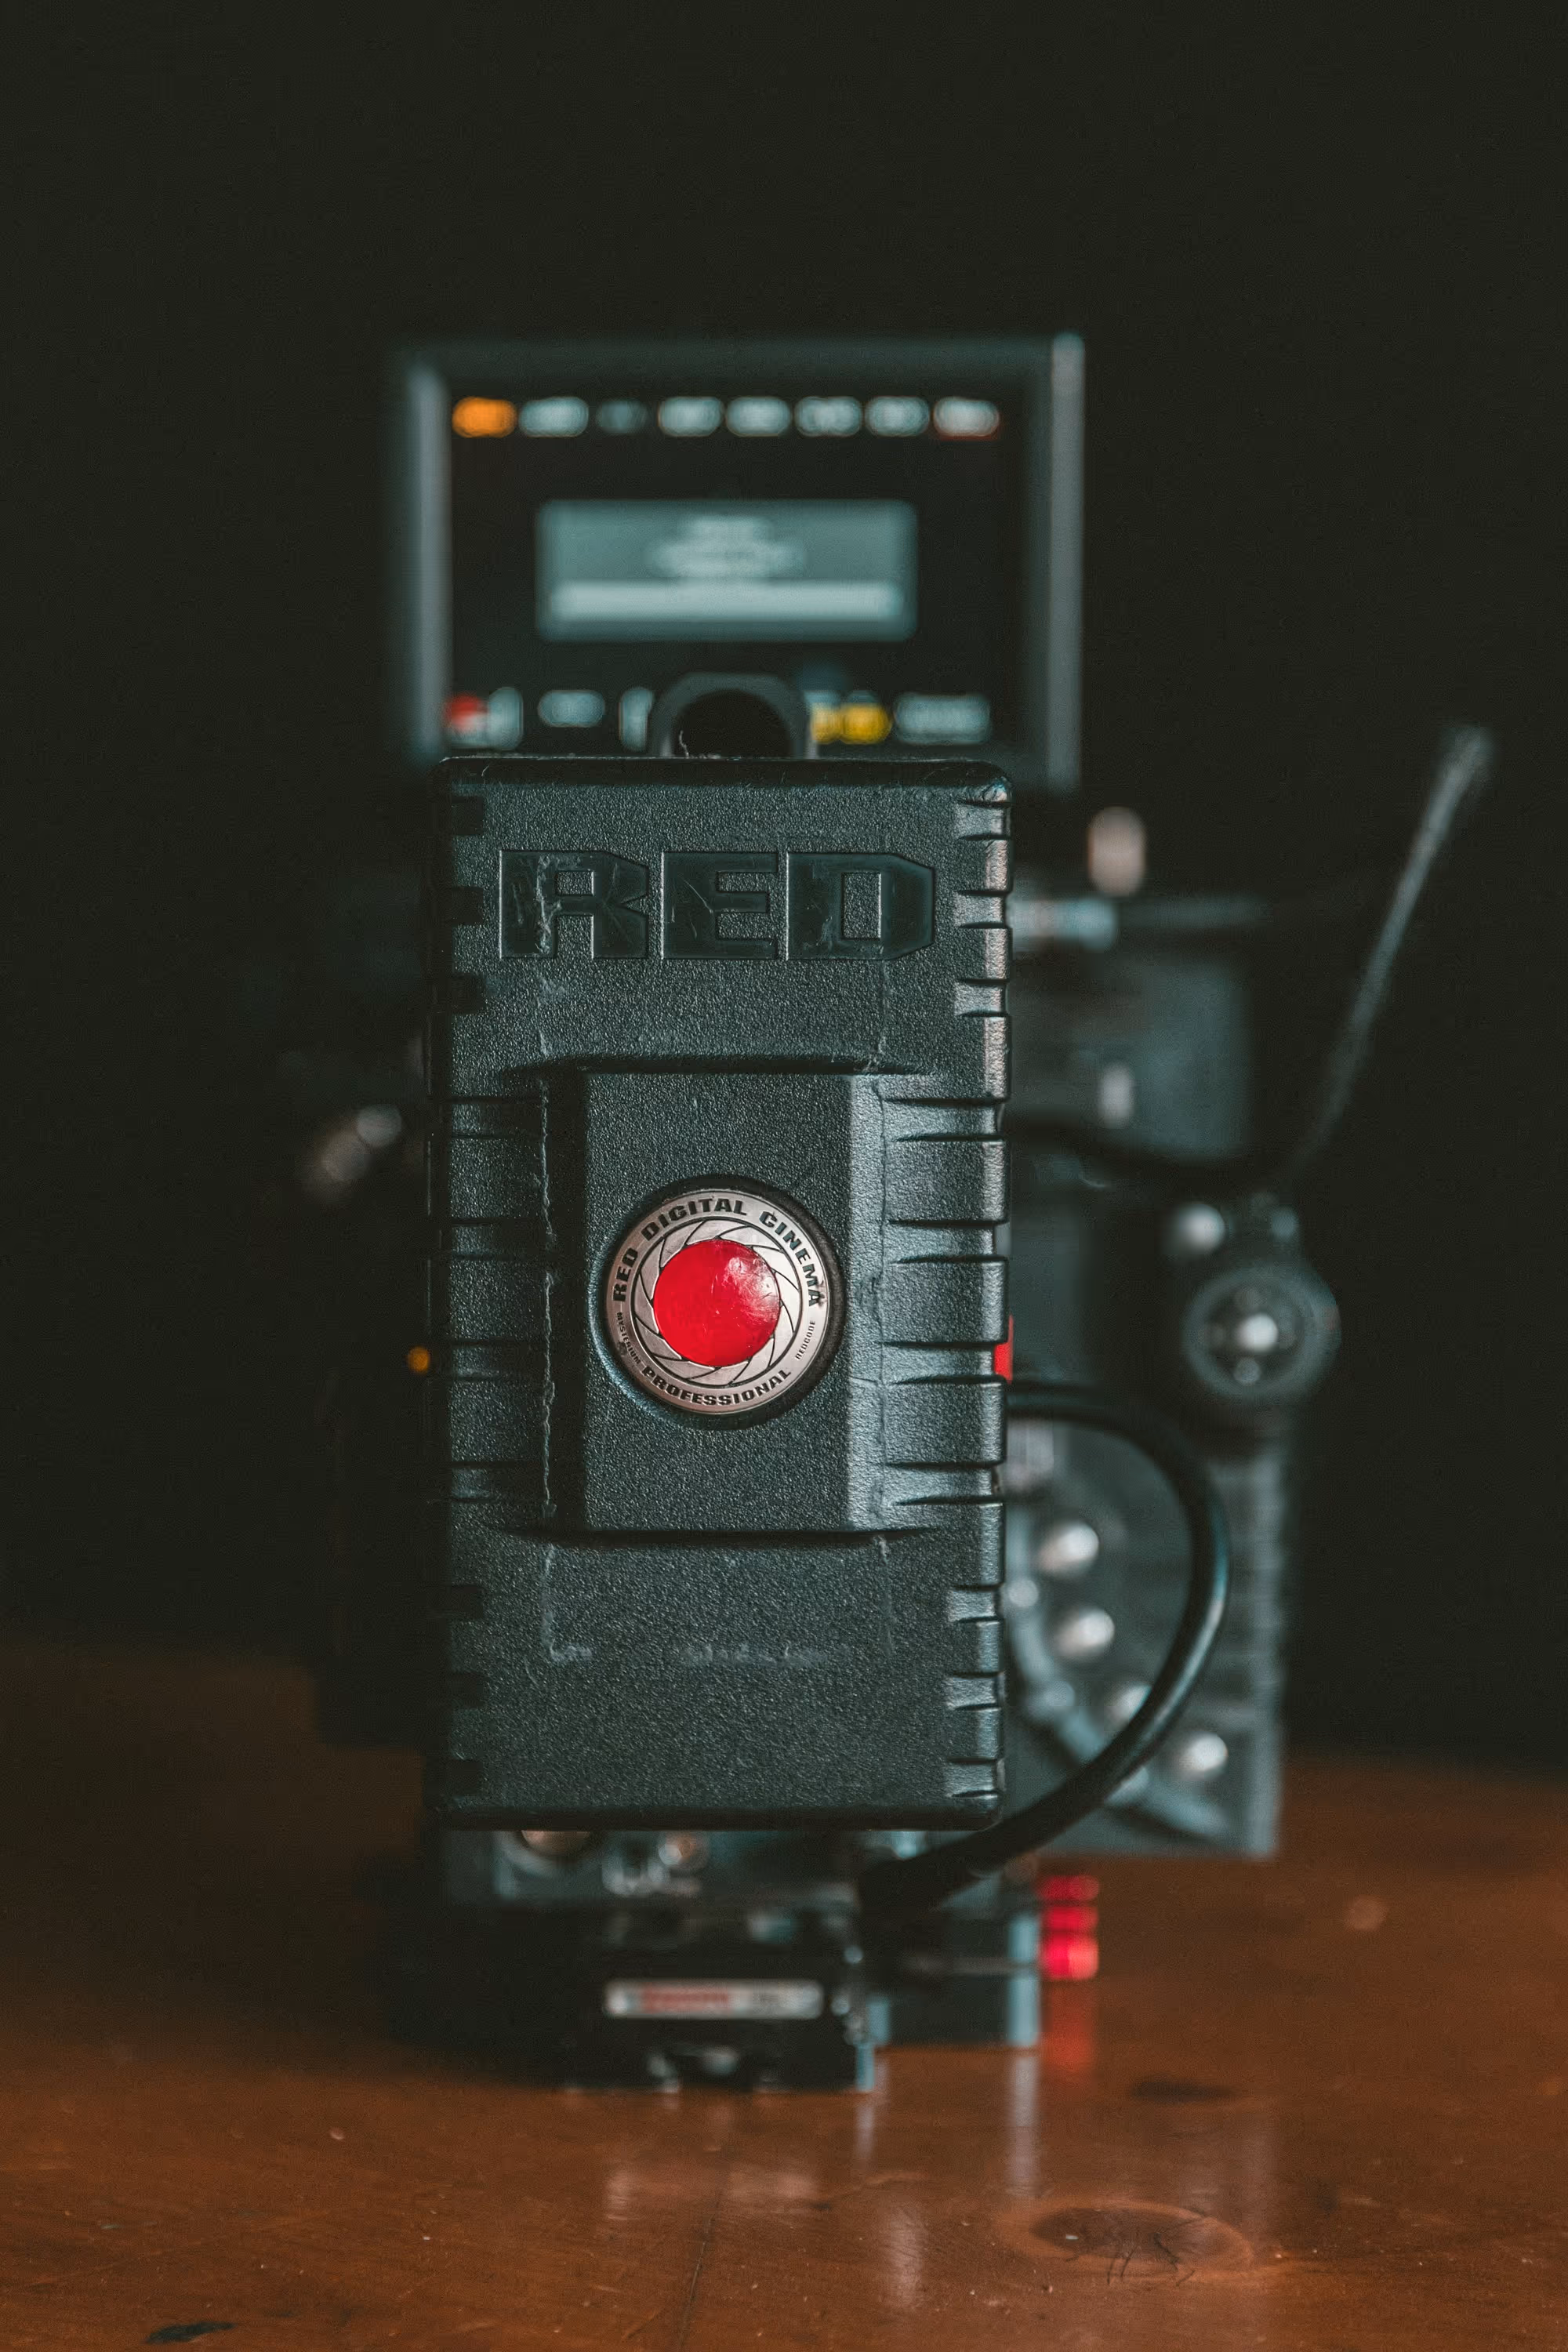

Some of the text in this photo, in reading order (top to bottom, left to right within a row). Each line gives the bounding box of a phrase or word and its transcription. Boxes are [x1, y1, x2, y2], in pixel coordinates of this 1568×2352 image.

[499, 850, 936, 960] RED
[612, 1197, 826, 1307] RED DIGITAL CINEMA
[616, 1312, 641, 1365] MYSTERIUM
[795, 1320, 816, 1360] REDCODE
[641, 1367, 791, 1406] PROFESSIONAL
